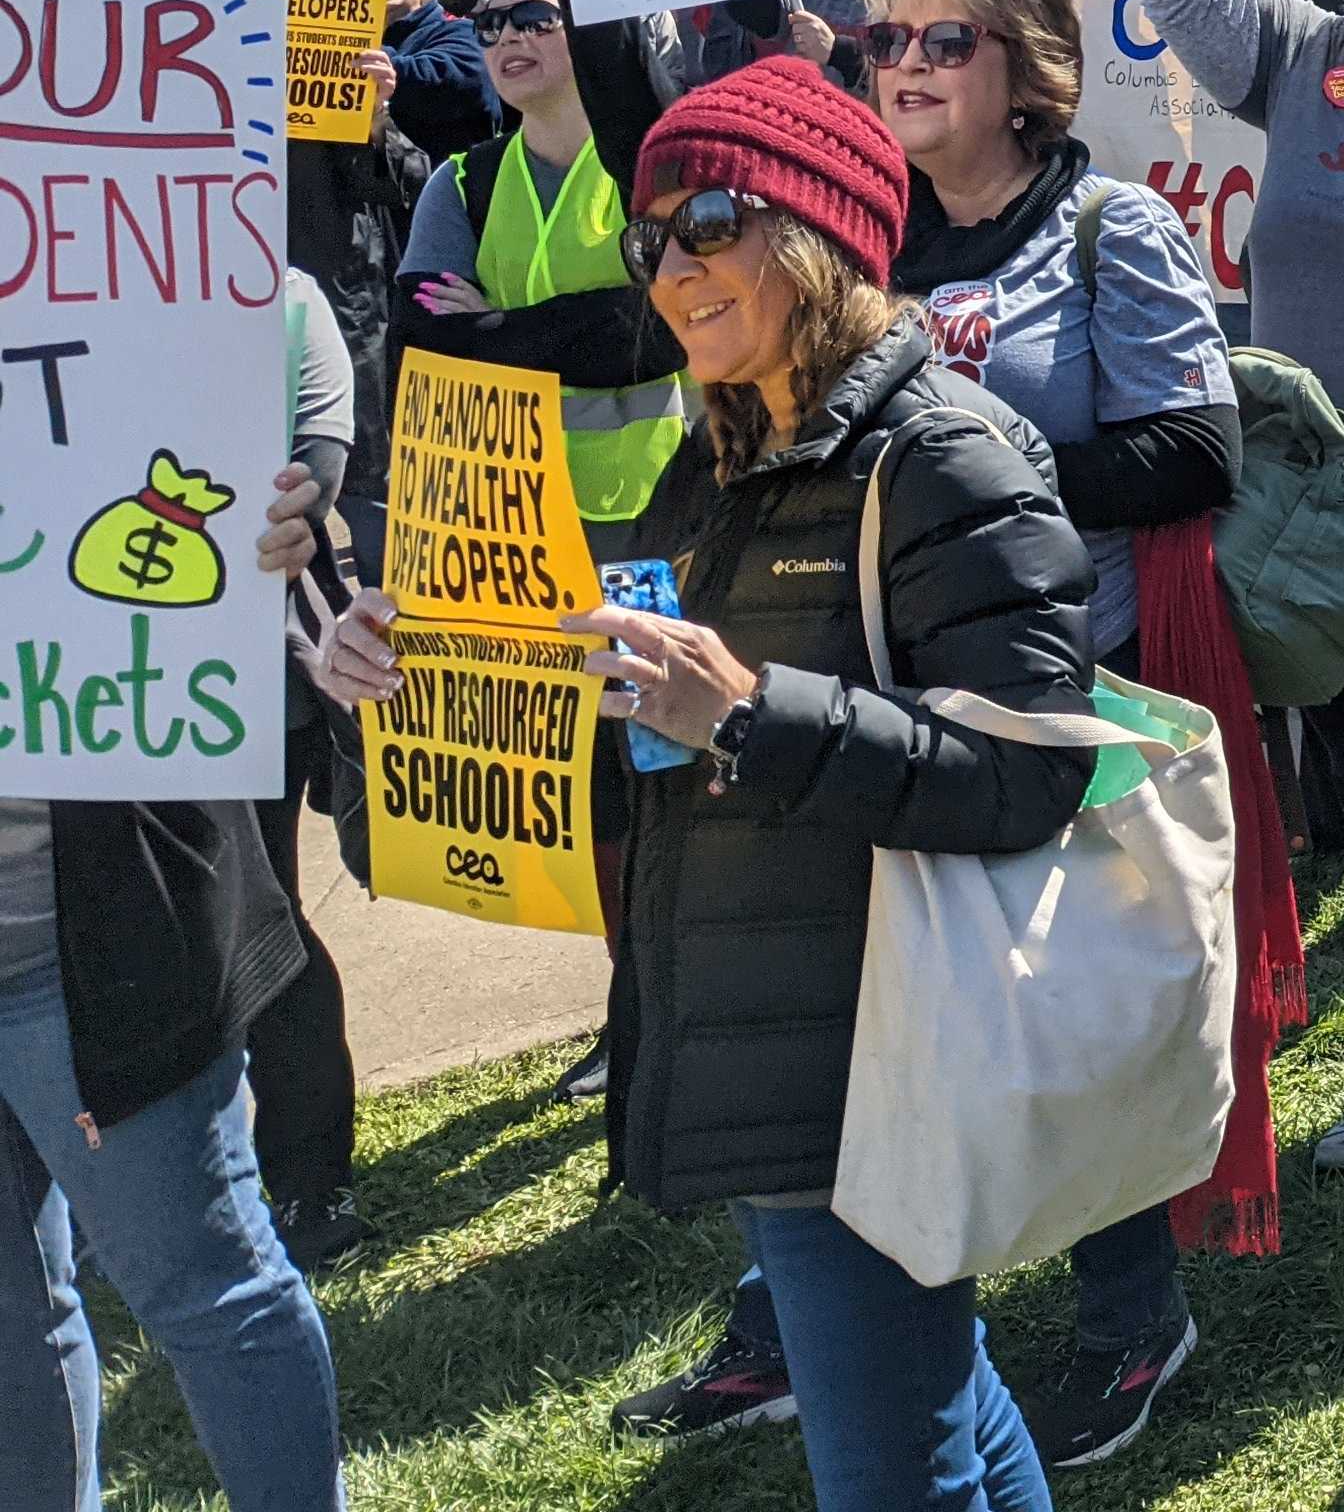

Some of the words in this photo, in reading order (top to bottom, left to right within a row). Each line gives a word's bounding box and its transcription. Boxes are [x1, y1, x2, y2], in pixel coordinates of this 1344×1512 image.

[1104, 60, 1178, 87] Columbus
[402, 370, 428, 434] END
[433, 377, 543, 464] HANDOUTS
[397, 445, 418, 512] TO
[420, 451, 545, 536] WEALTHY
[392, 519, 574, 611] DEVELOPERS.
[785, 557, 846, 573] Columbia
[454, 636, 522, 666] STUDENTS
[443, 673, 580, 763] RESOURCED
[382, 743, 573, 851] SCHOOLS!
